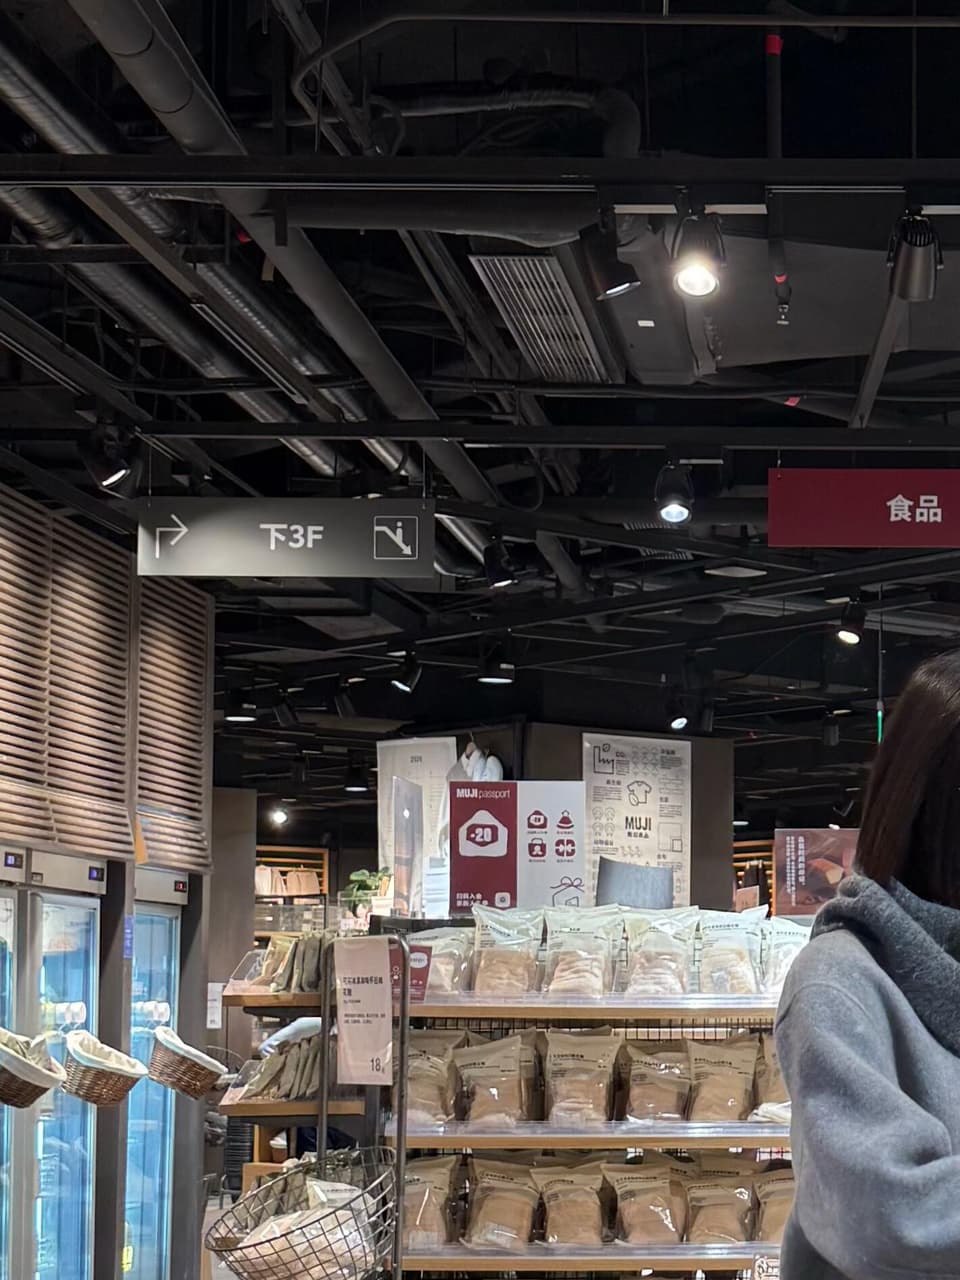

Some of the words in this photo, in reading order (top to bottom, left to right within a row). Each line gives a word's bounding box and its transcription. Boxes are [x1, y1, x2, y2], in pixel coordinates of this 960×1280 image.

[886, 494, 942, 523] 食品
[259, 523, 324, 550] 下3F
[456, 788, 478, 799] MUJI
[479, 789, 511, 800] passport
[625, 816, 652, 831] MUJI
